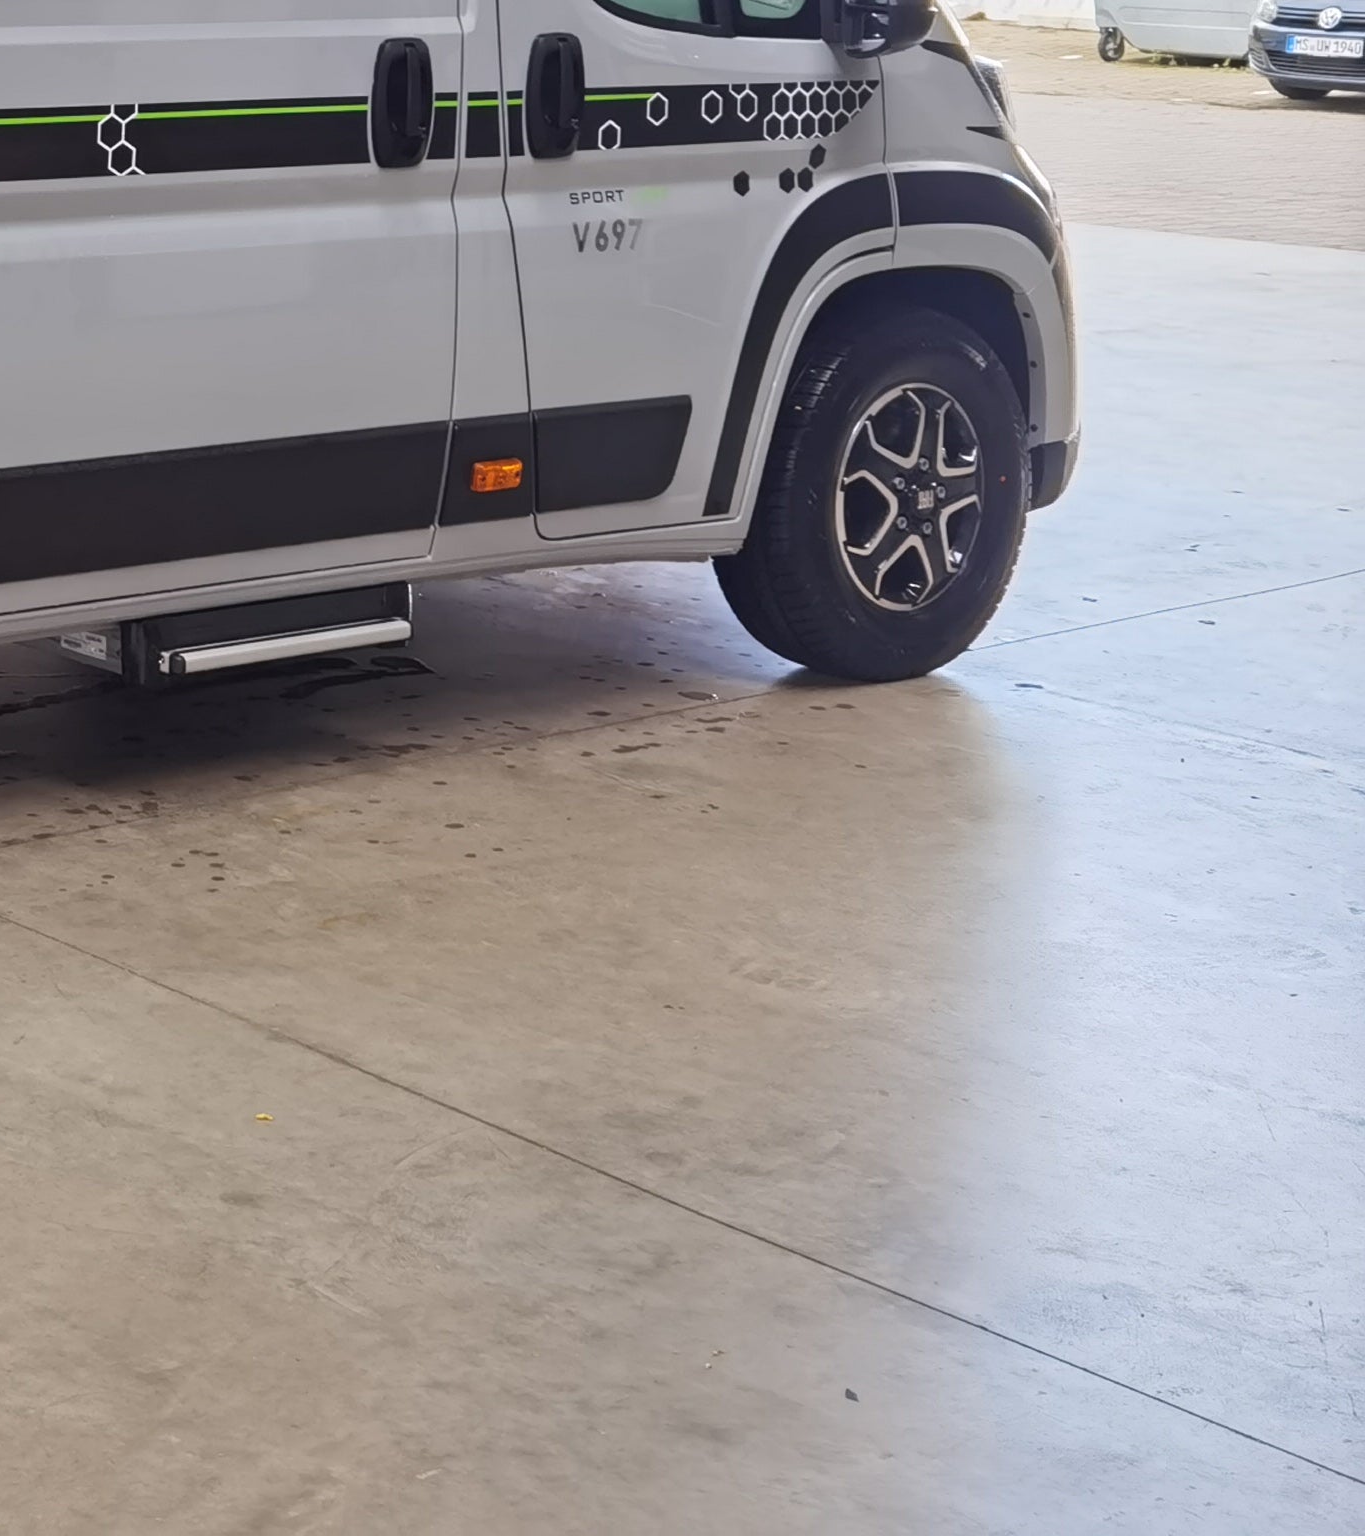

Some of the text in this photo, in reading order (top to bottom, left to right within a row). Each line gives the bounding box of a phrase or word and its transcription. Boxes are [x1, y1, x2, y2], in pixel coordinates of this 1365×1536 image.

[1295, 38, 1309, 51] MS
[1333, 41, 1362, 55] 1940
[569, 189, 624, 205] SPORT
[572, 218, 643, 253] V697
